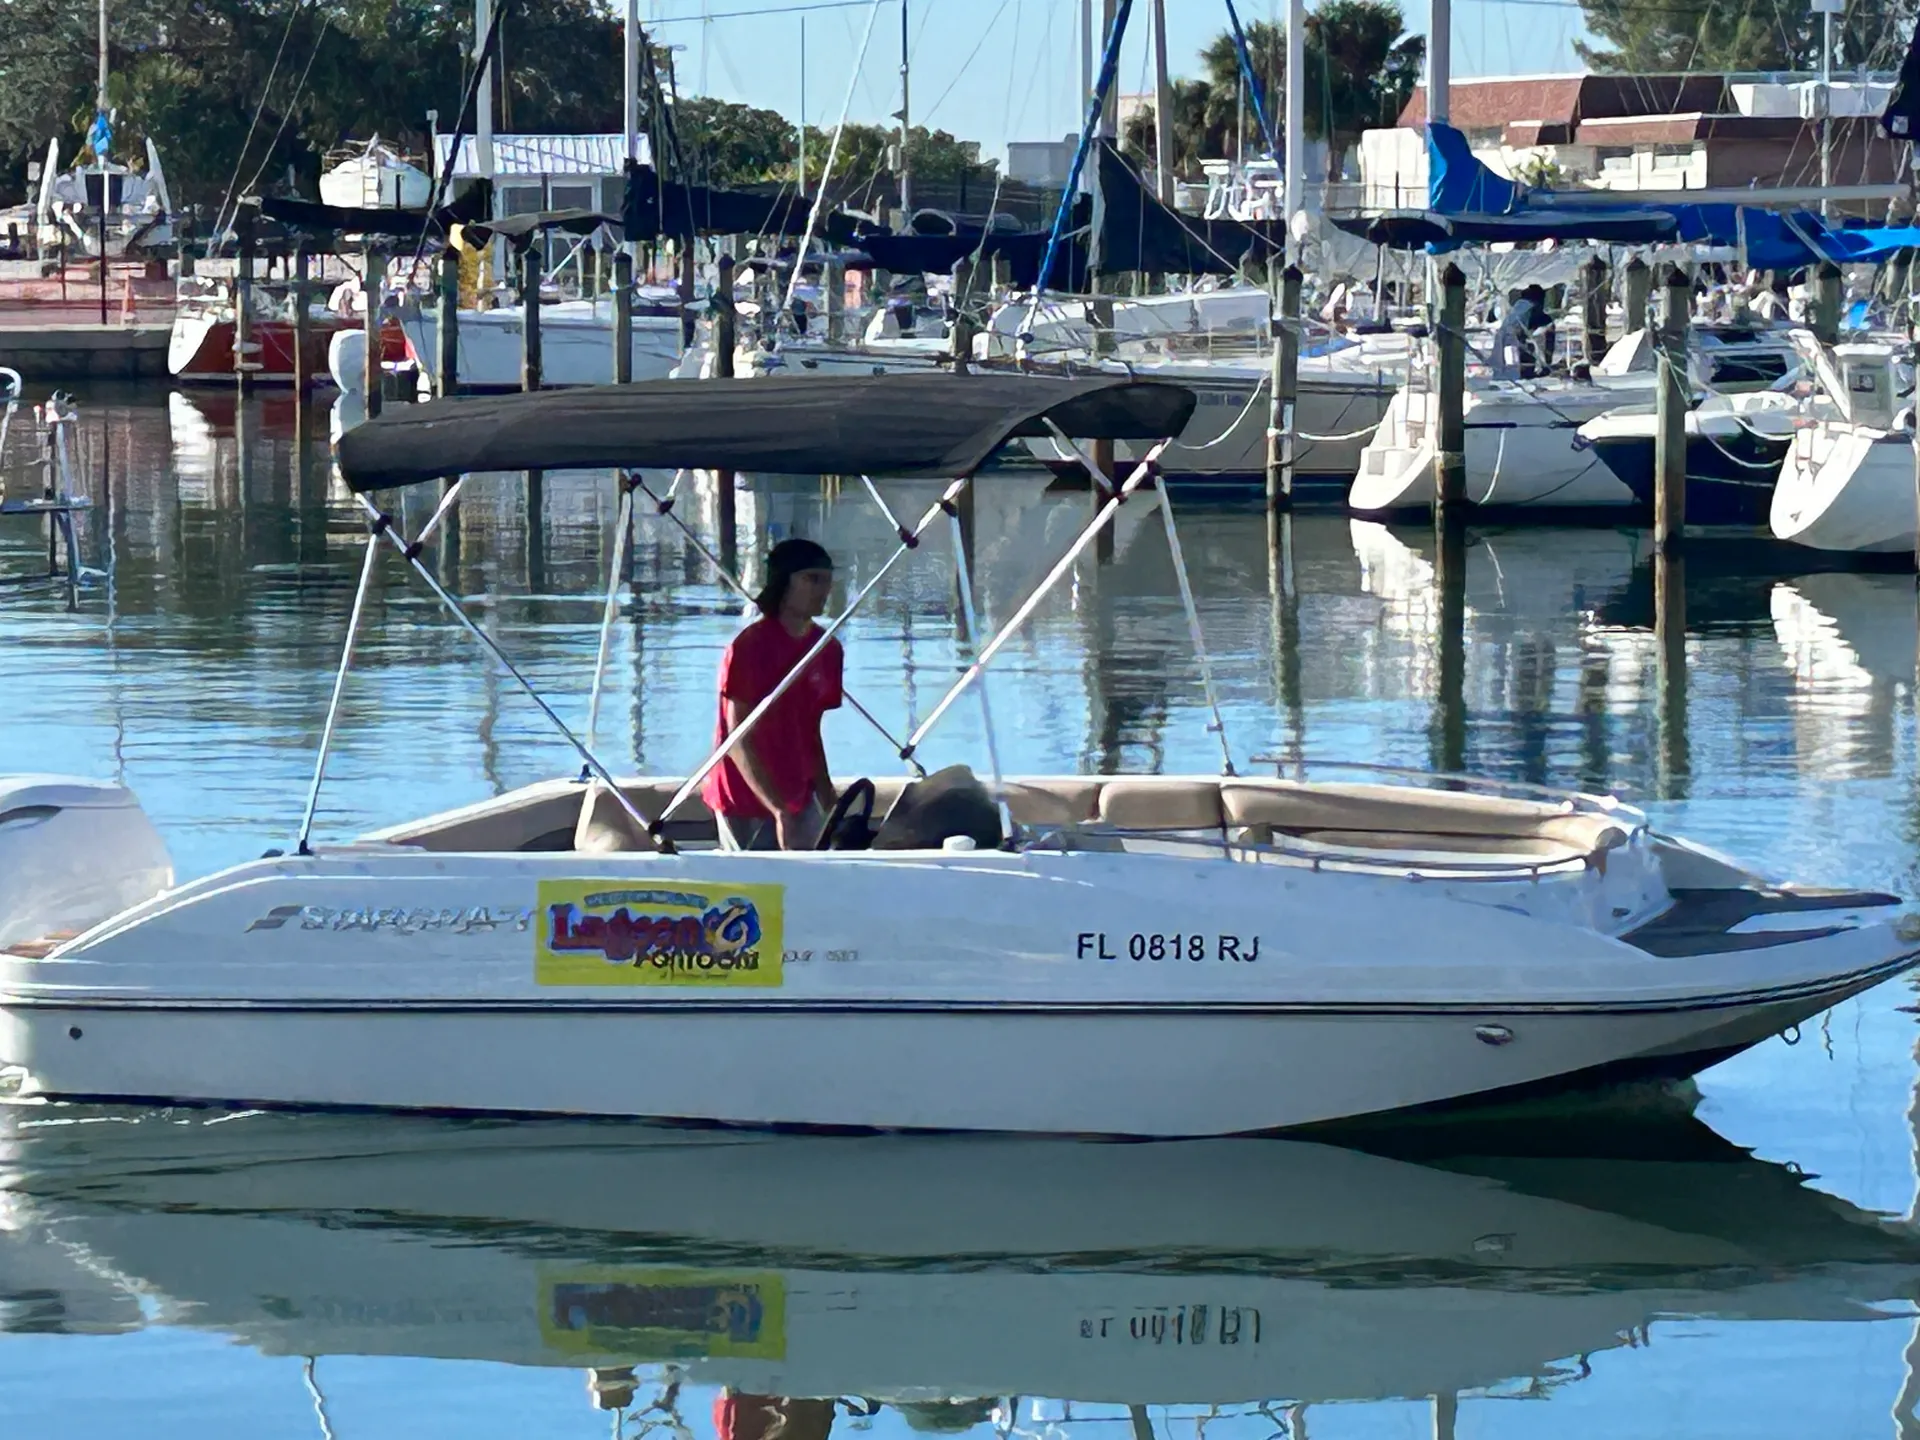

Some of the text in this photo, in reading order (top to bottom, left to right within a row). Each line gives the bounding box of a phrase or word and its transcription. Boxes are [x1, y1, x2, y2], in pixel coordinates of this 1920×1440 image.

[1077, 933, 1259, 962] FL 0818 RJ
